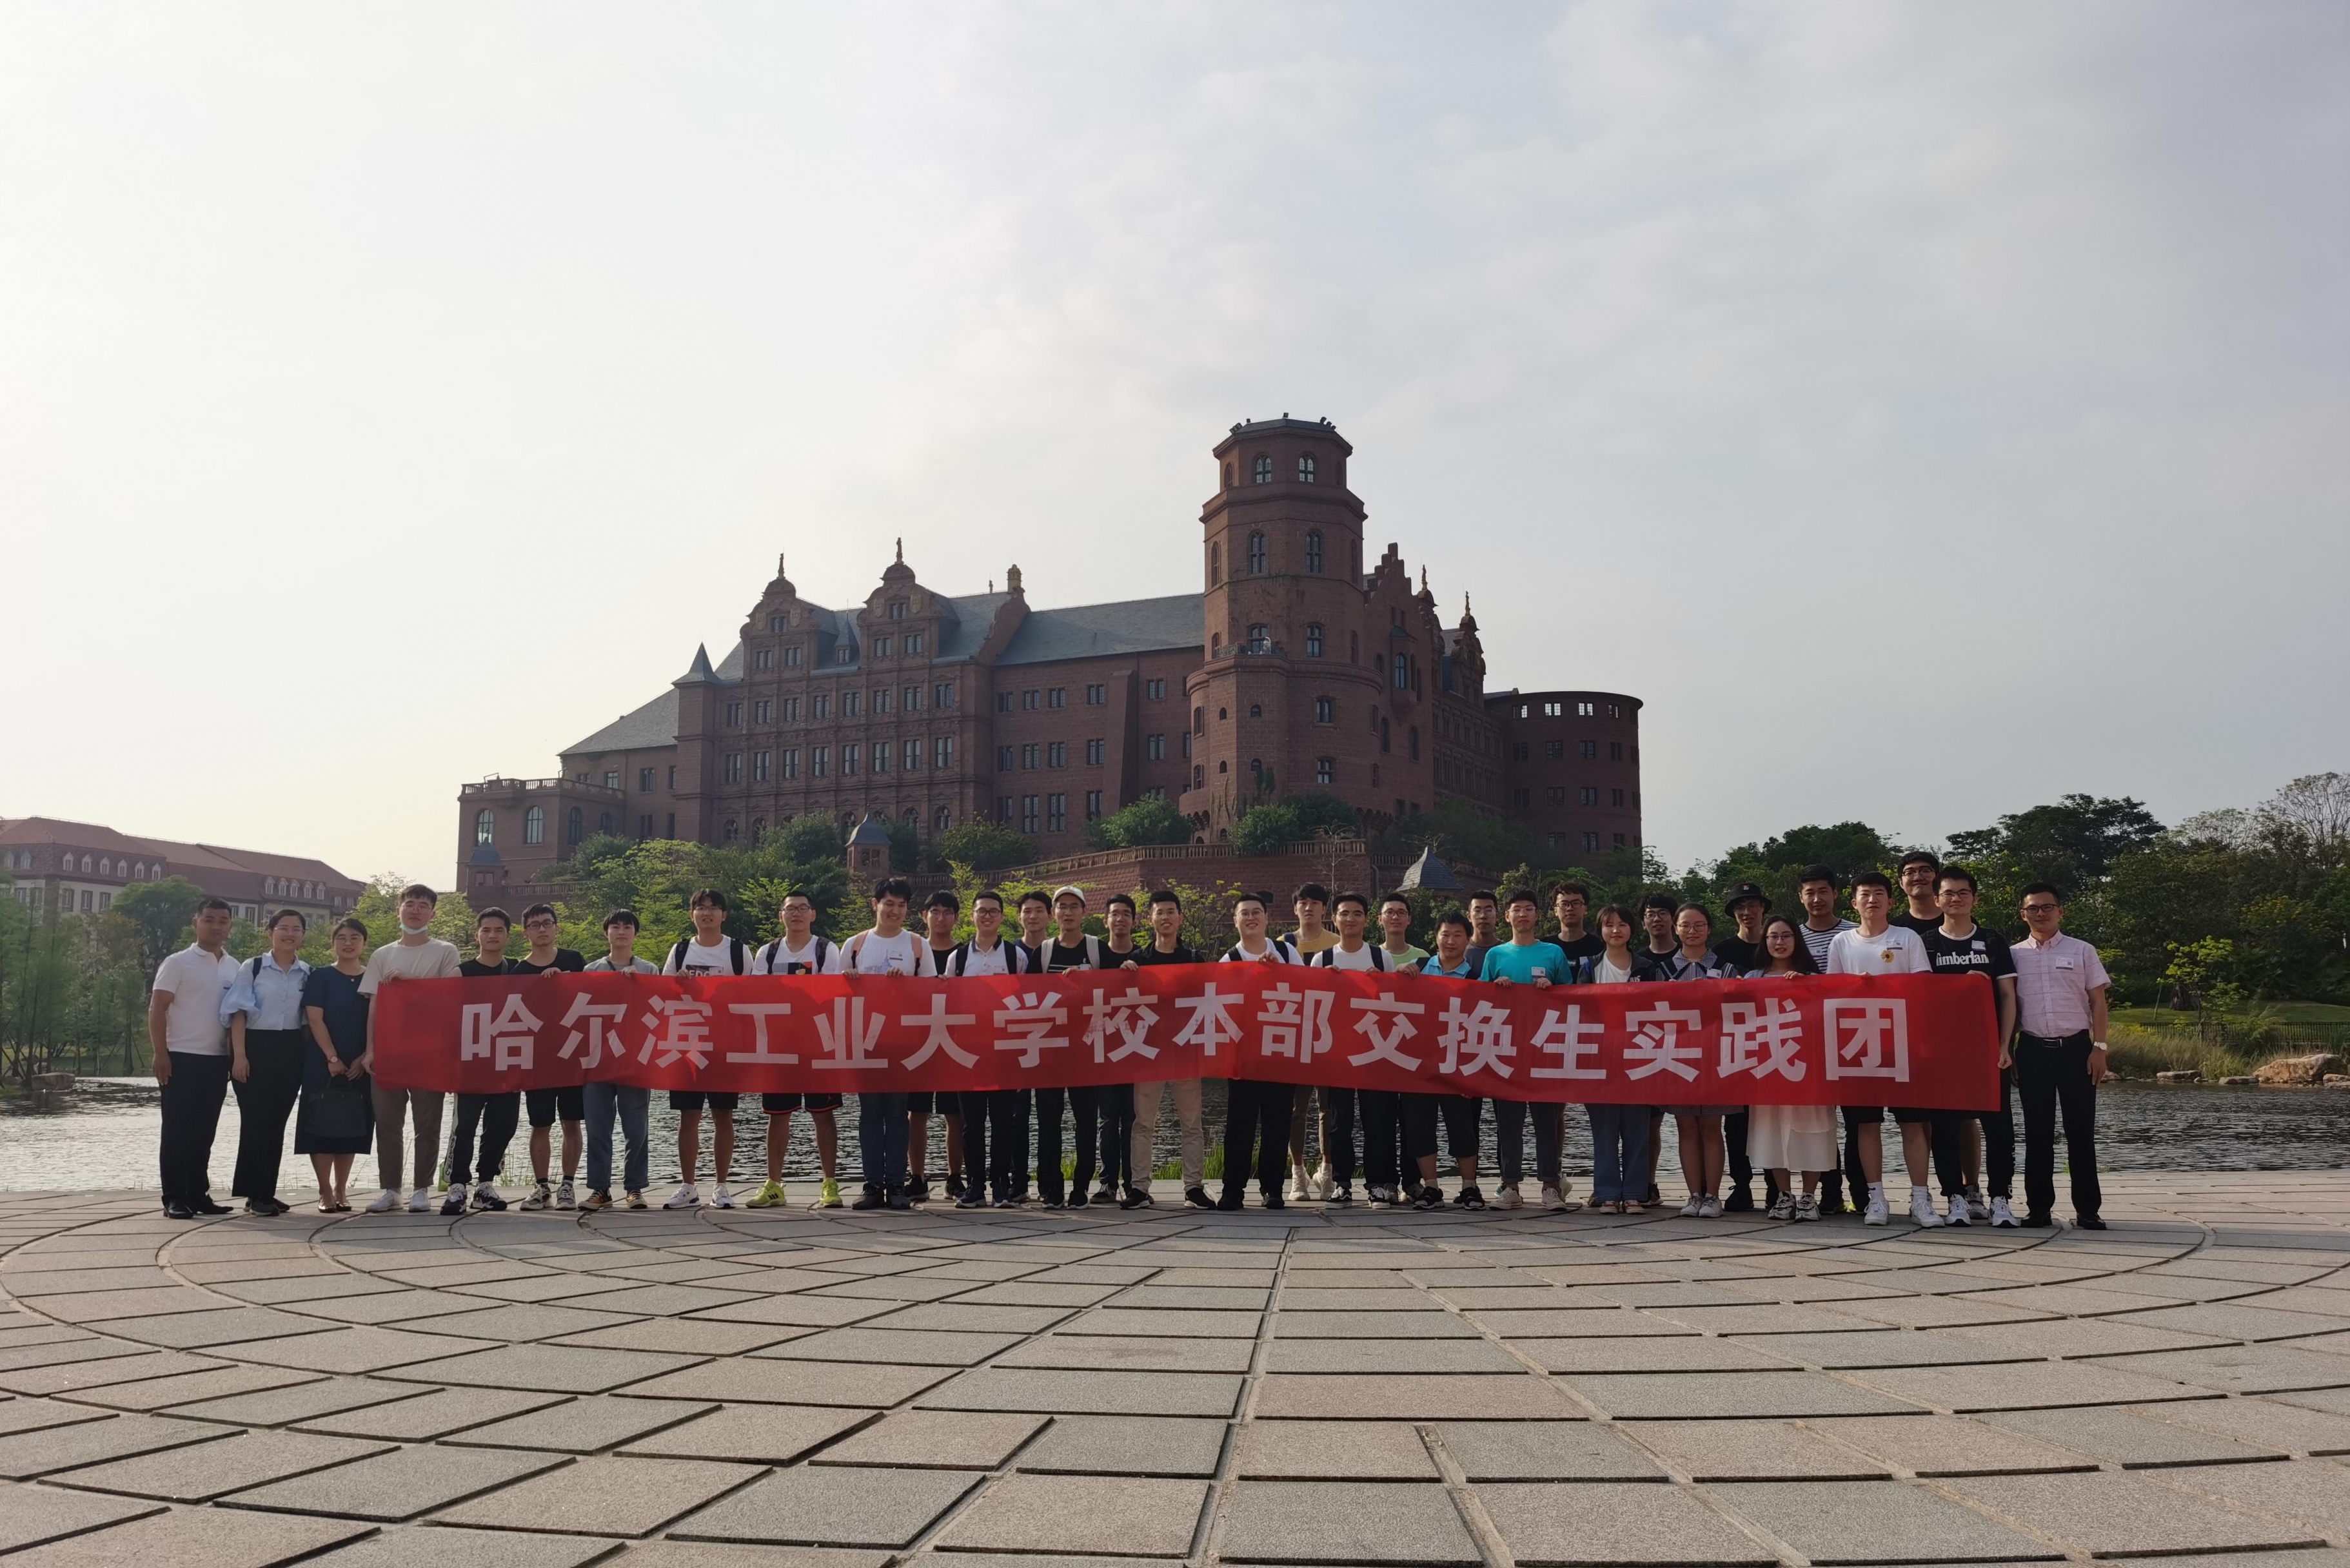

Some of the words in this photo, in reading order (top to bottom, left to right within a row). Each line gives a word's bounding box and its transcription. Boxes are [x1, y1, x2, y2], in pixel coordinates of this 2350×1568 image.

[460, 982, 1910, 1083] 哈尔滨工业大学校本部交换生实践团
